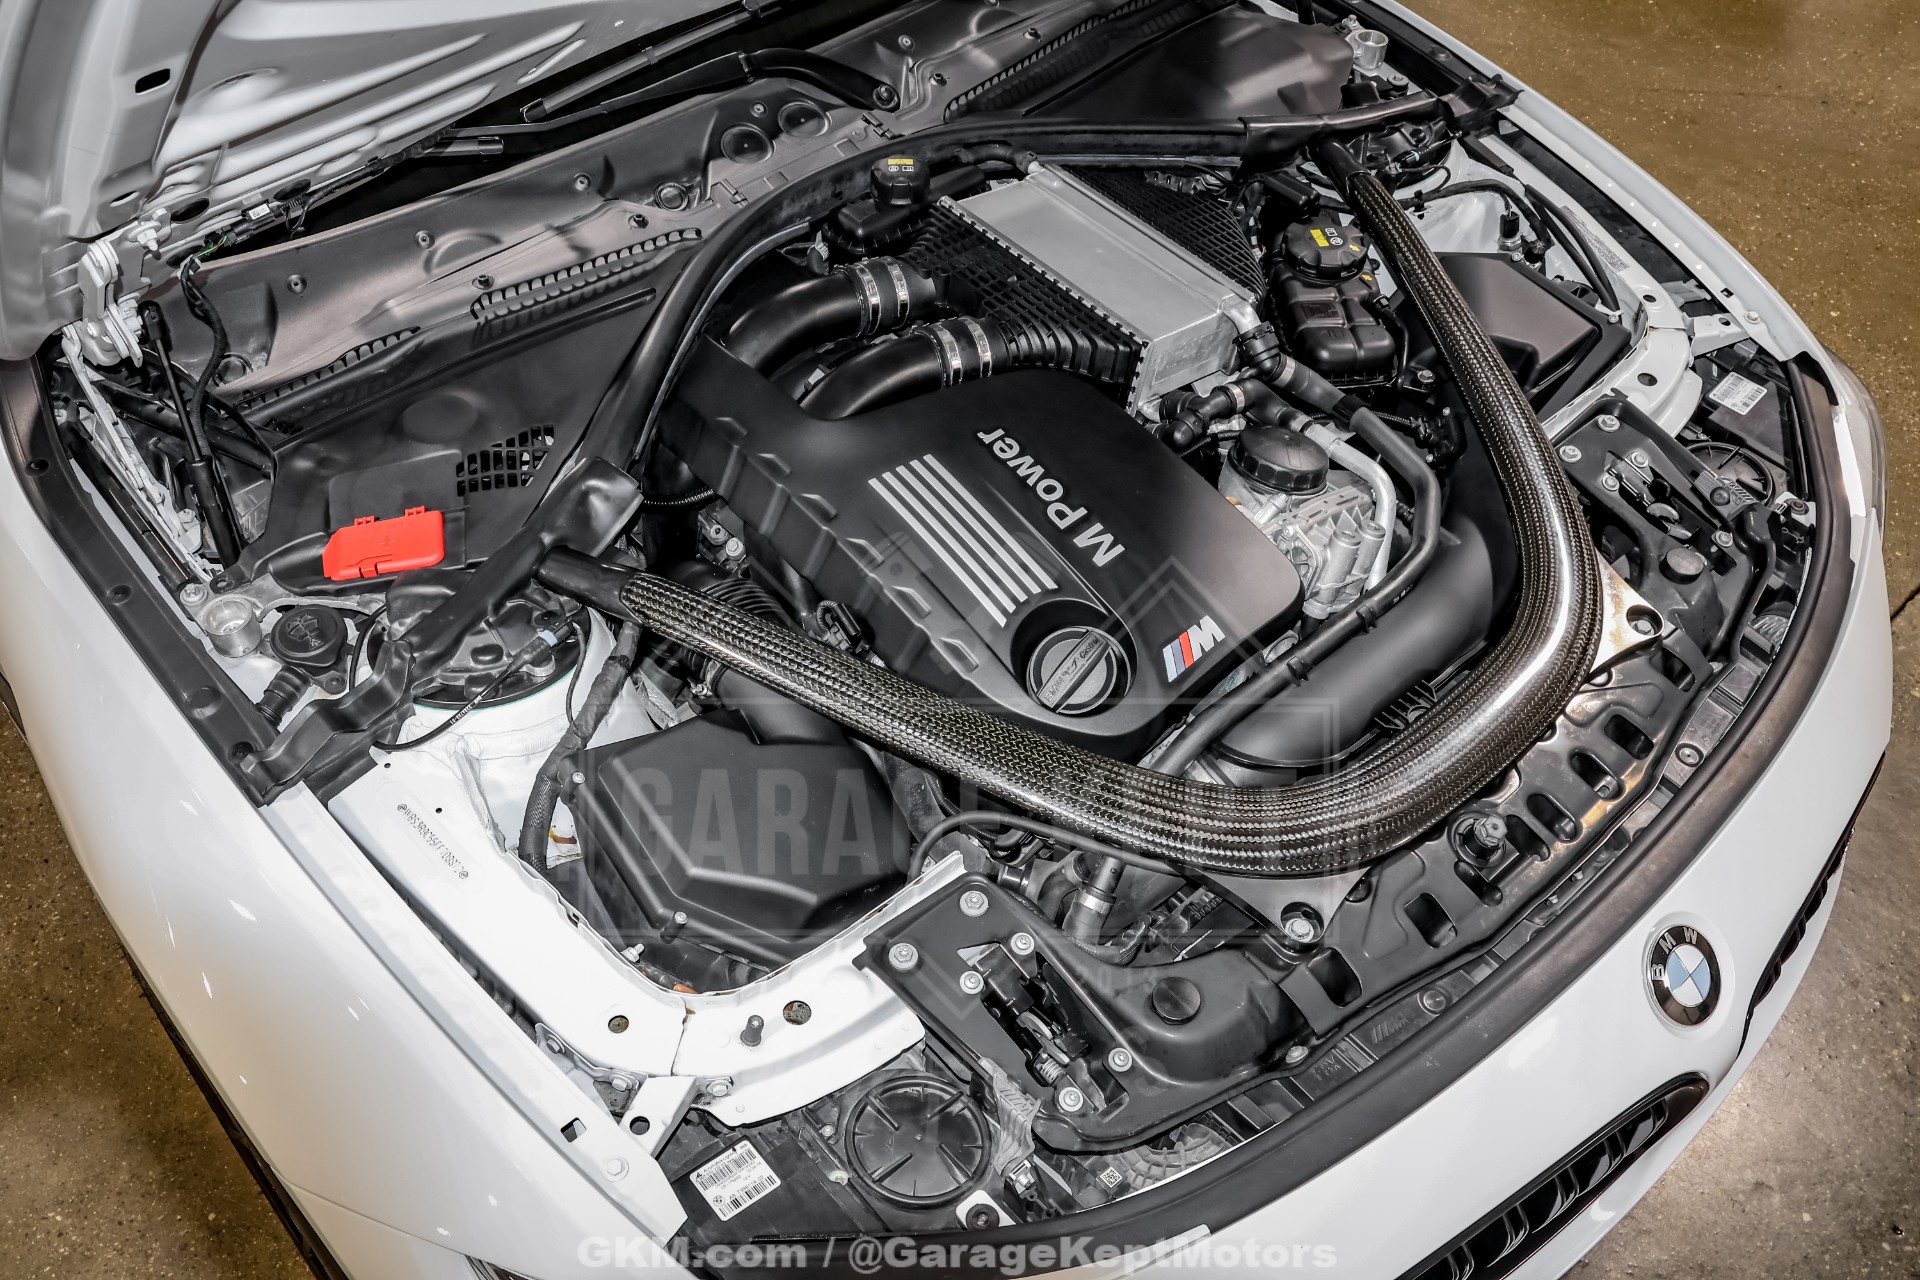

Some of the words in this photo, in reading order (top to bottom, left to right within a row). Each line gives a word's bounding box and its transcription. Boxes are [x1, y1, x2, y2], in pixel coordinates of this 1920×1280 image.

[977, 428, 1088, 530] Power
[1073, 522, 1125, 567] M
[1080, 635, 1100, 659] Castrol
[1651, 926, 1698, 981] BMW
